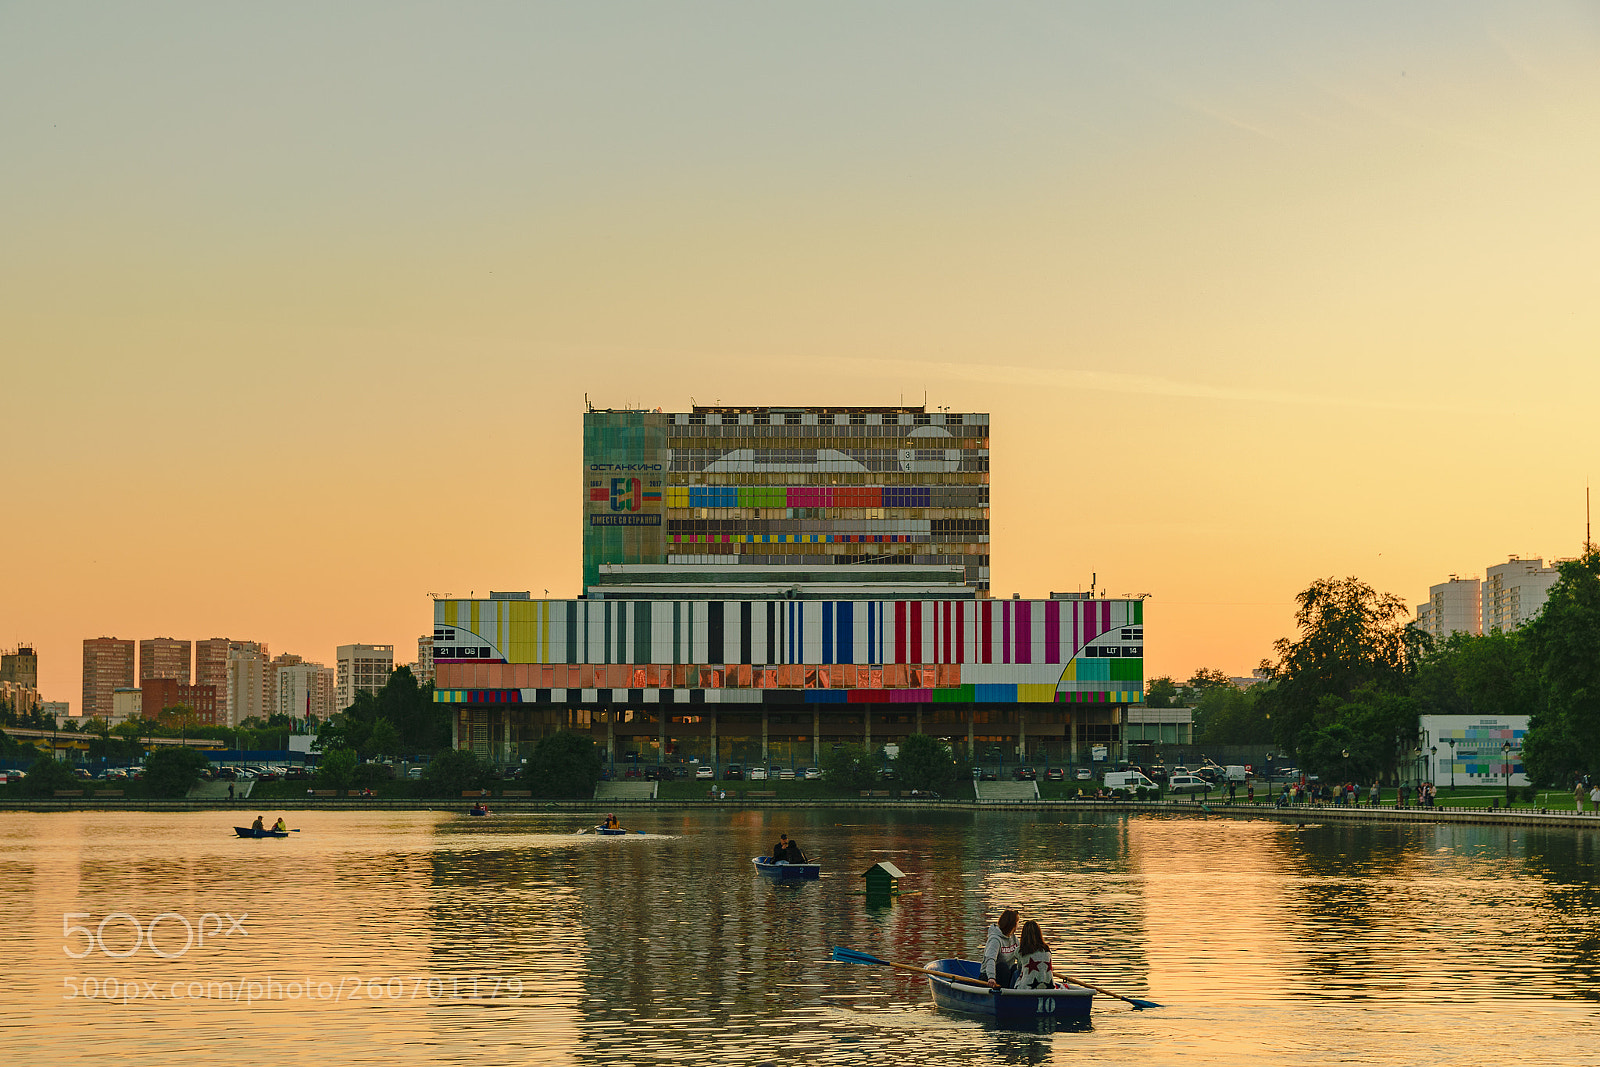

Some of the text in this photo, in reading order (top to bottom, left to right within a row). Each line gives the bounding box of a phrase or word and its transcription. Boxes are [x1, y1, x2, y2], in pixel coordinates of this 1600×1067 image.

[905, 451, 911, 459] 3
[590, 463, 662, 471] ОСТАНКИНО
[905, 463, 911, 471] 4
[611, 477, 641, 512] 50
[440, 647, 449, 655] 21
[1036, 997, 1056, 1014] 10
